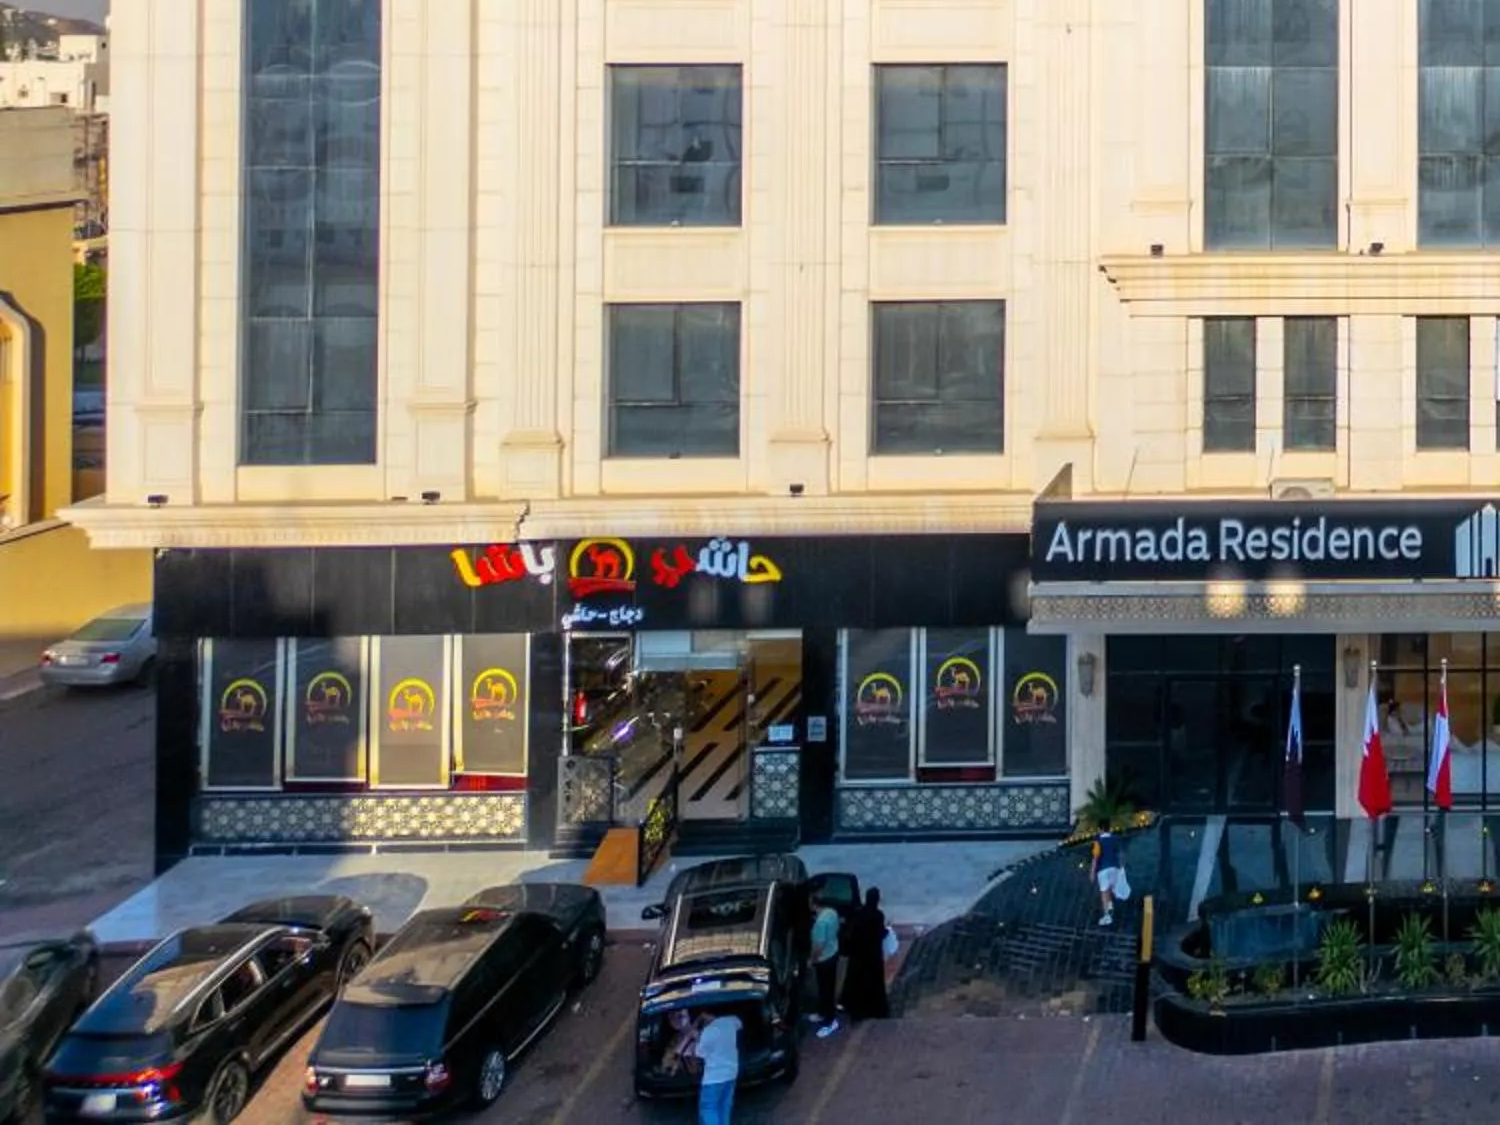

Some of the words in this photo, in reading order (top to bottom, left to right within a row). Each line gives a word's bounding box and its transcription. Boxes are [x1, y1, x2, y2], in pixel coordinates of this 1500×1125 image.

[651, 536, 781, 588] حاشي
[1045, 517, 1211, 563] Armada
[1219, 518, 1423, 562] Residence
[452, 543, 555, 586] باشا
